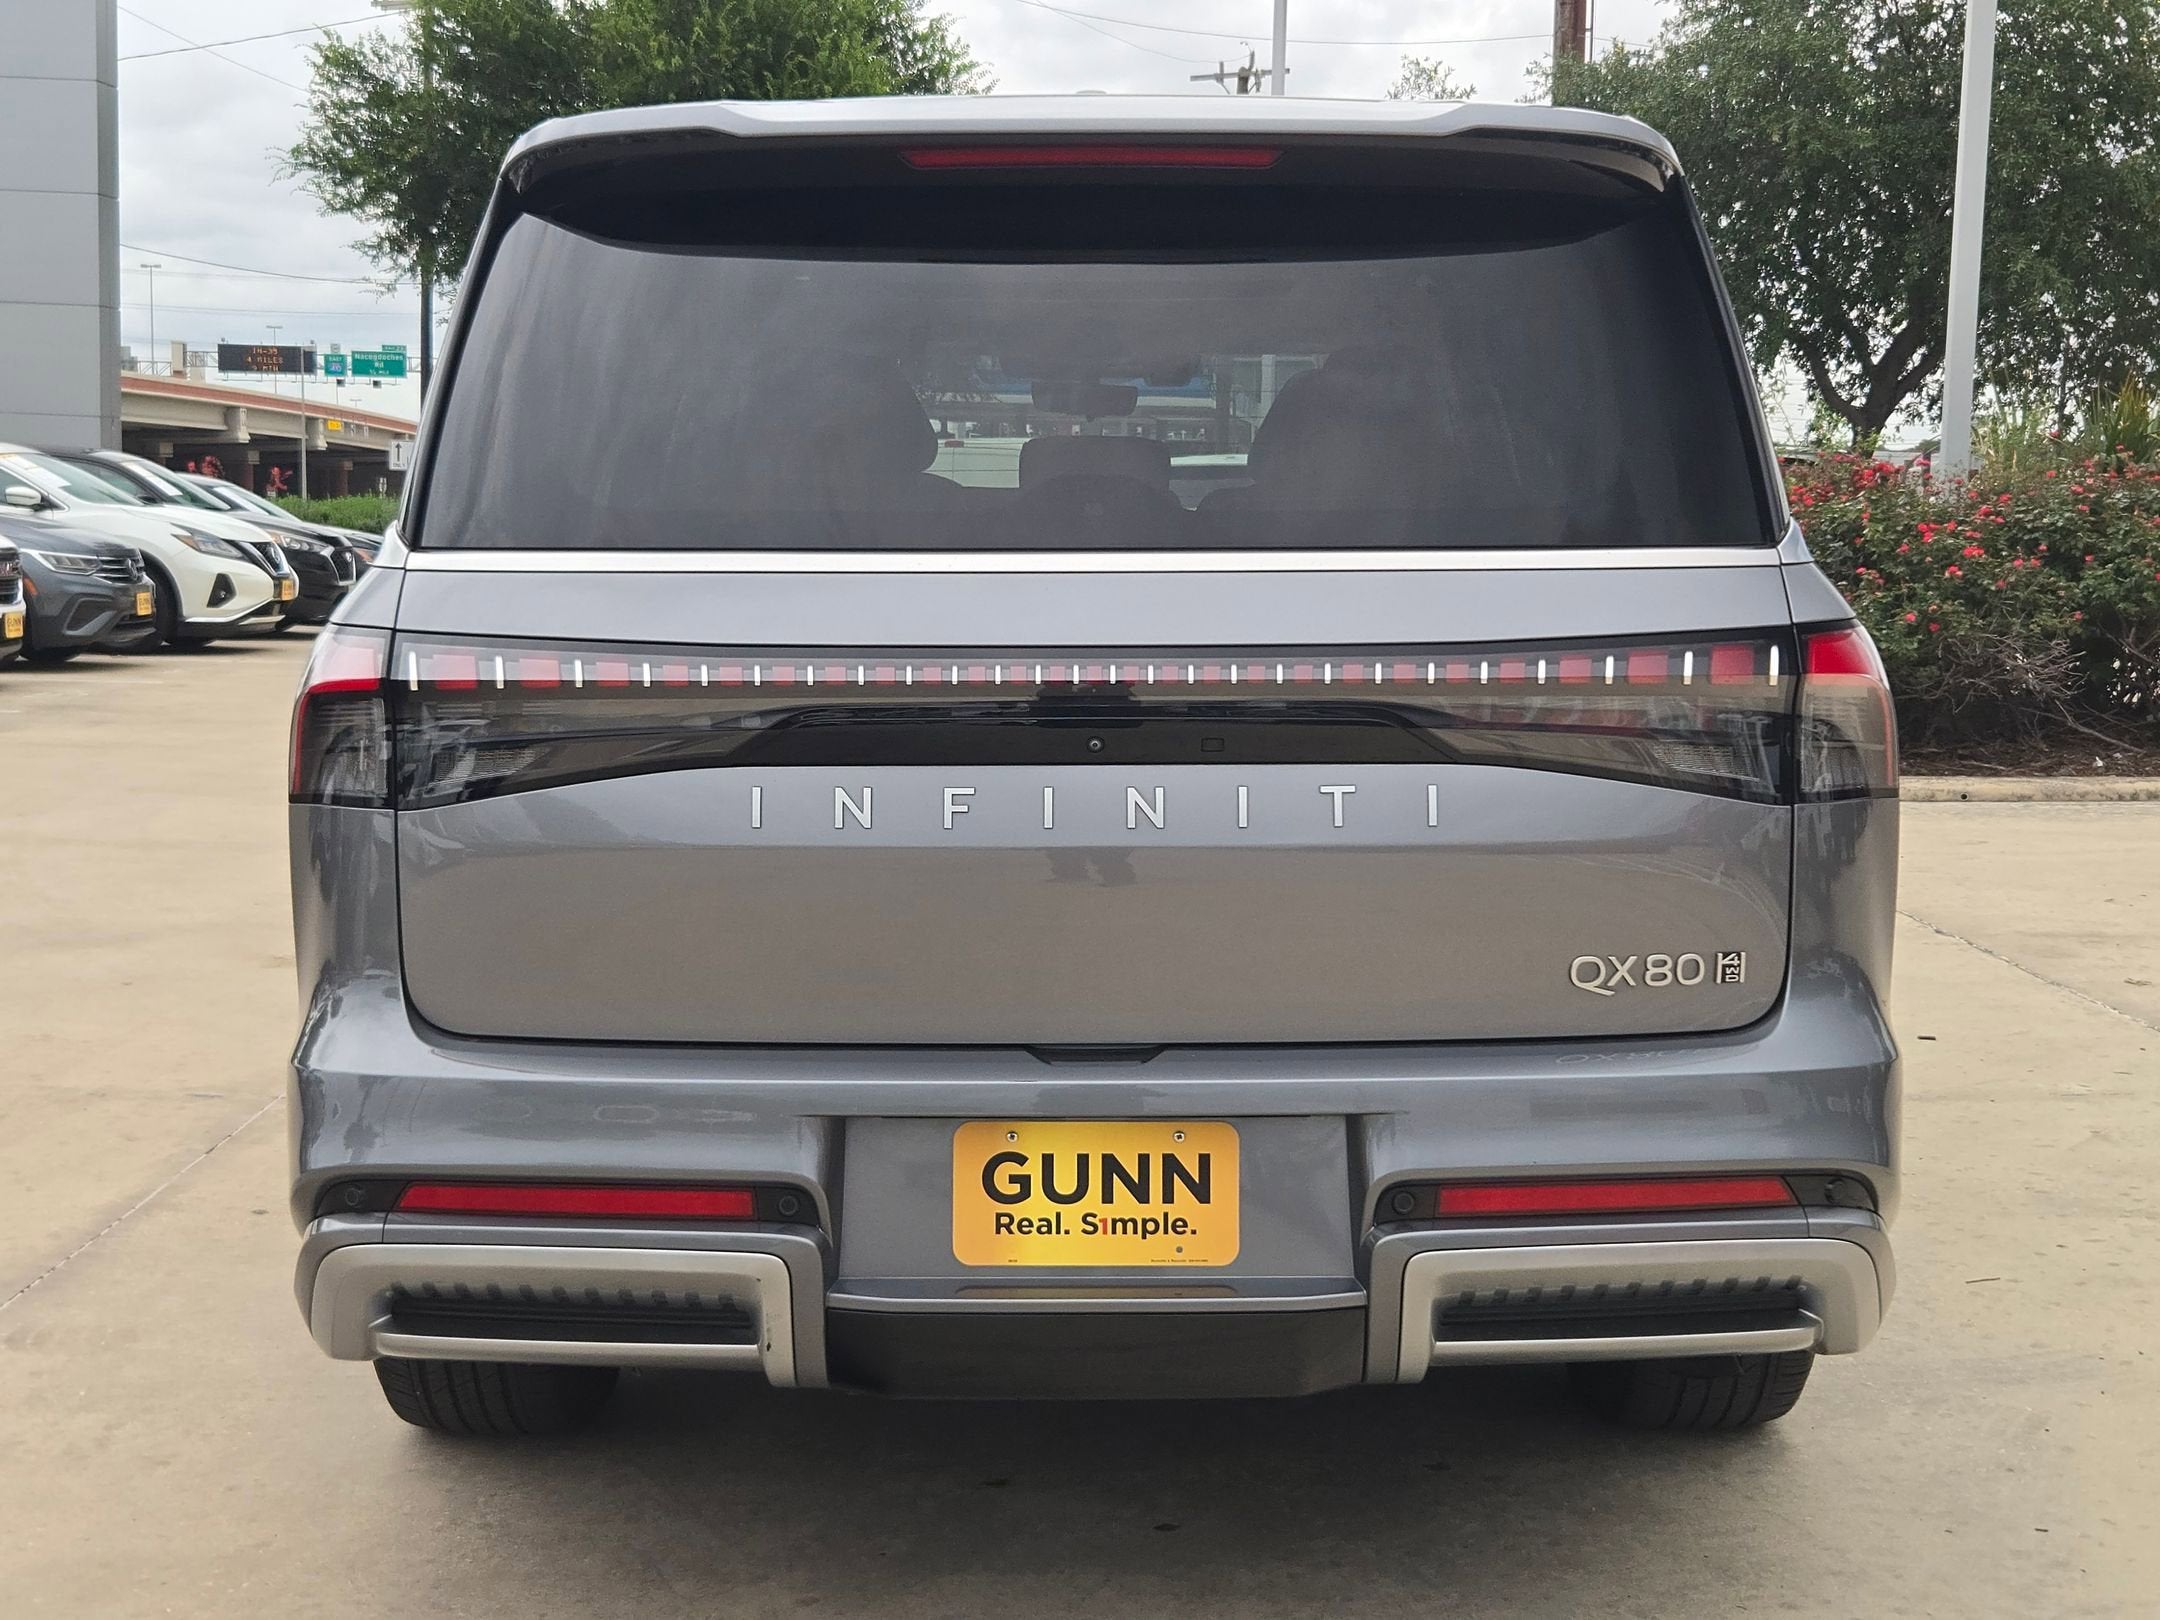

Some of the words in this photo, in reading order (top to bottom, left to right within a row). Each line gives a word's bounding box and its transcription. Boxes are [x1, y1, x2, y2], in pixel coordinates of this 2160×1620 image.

[257, 356, 284, 364] MILES
[354, 353, 404, 361] Nacogdoches
[751, 784, 1439, 829] INFINITI
[1570, 952, 1705, 996] QX80
[981, 1150, 1212, 1205] GUNN
[994, 1212, 1071, 1236] Real.
